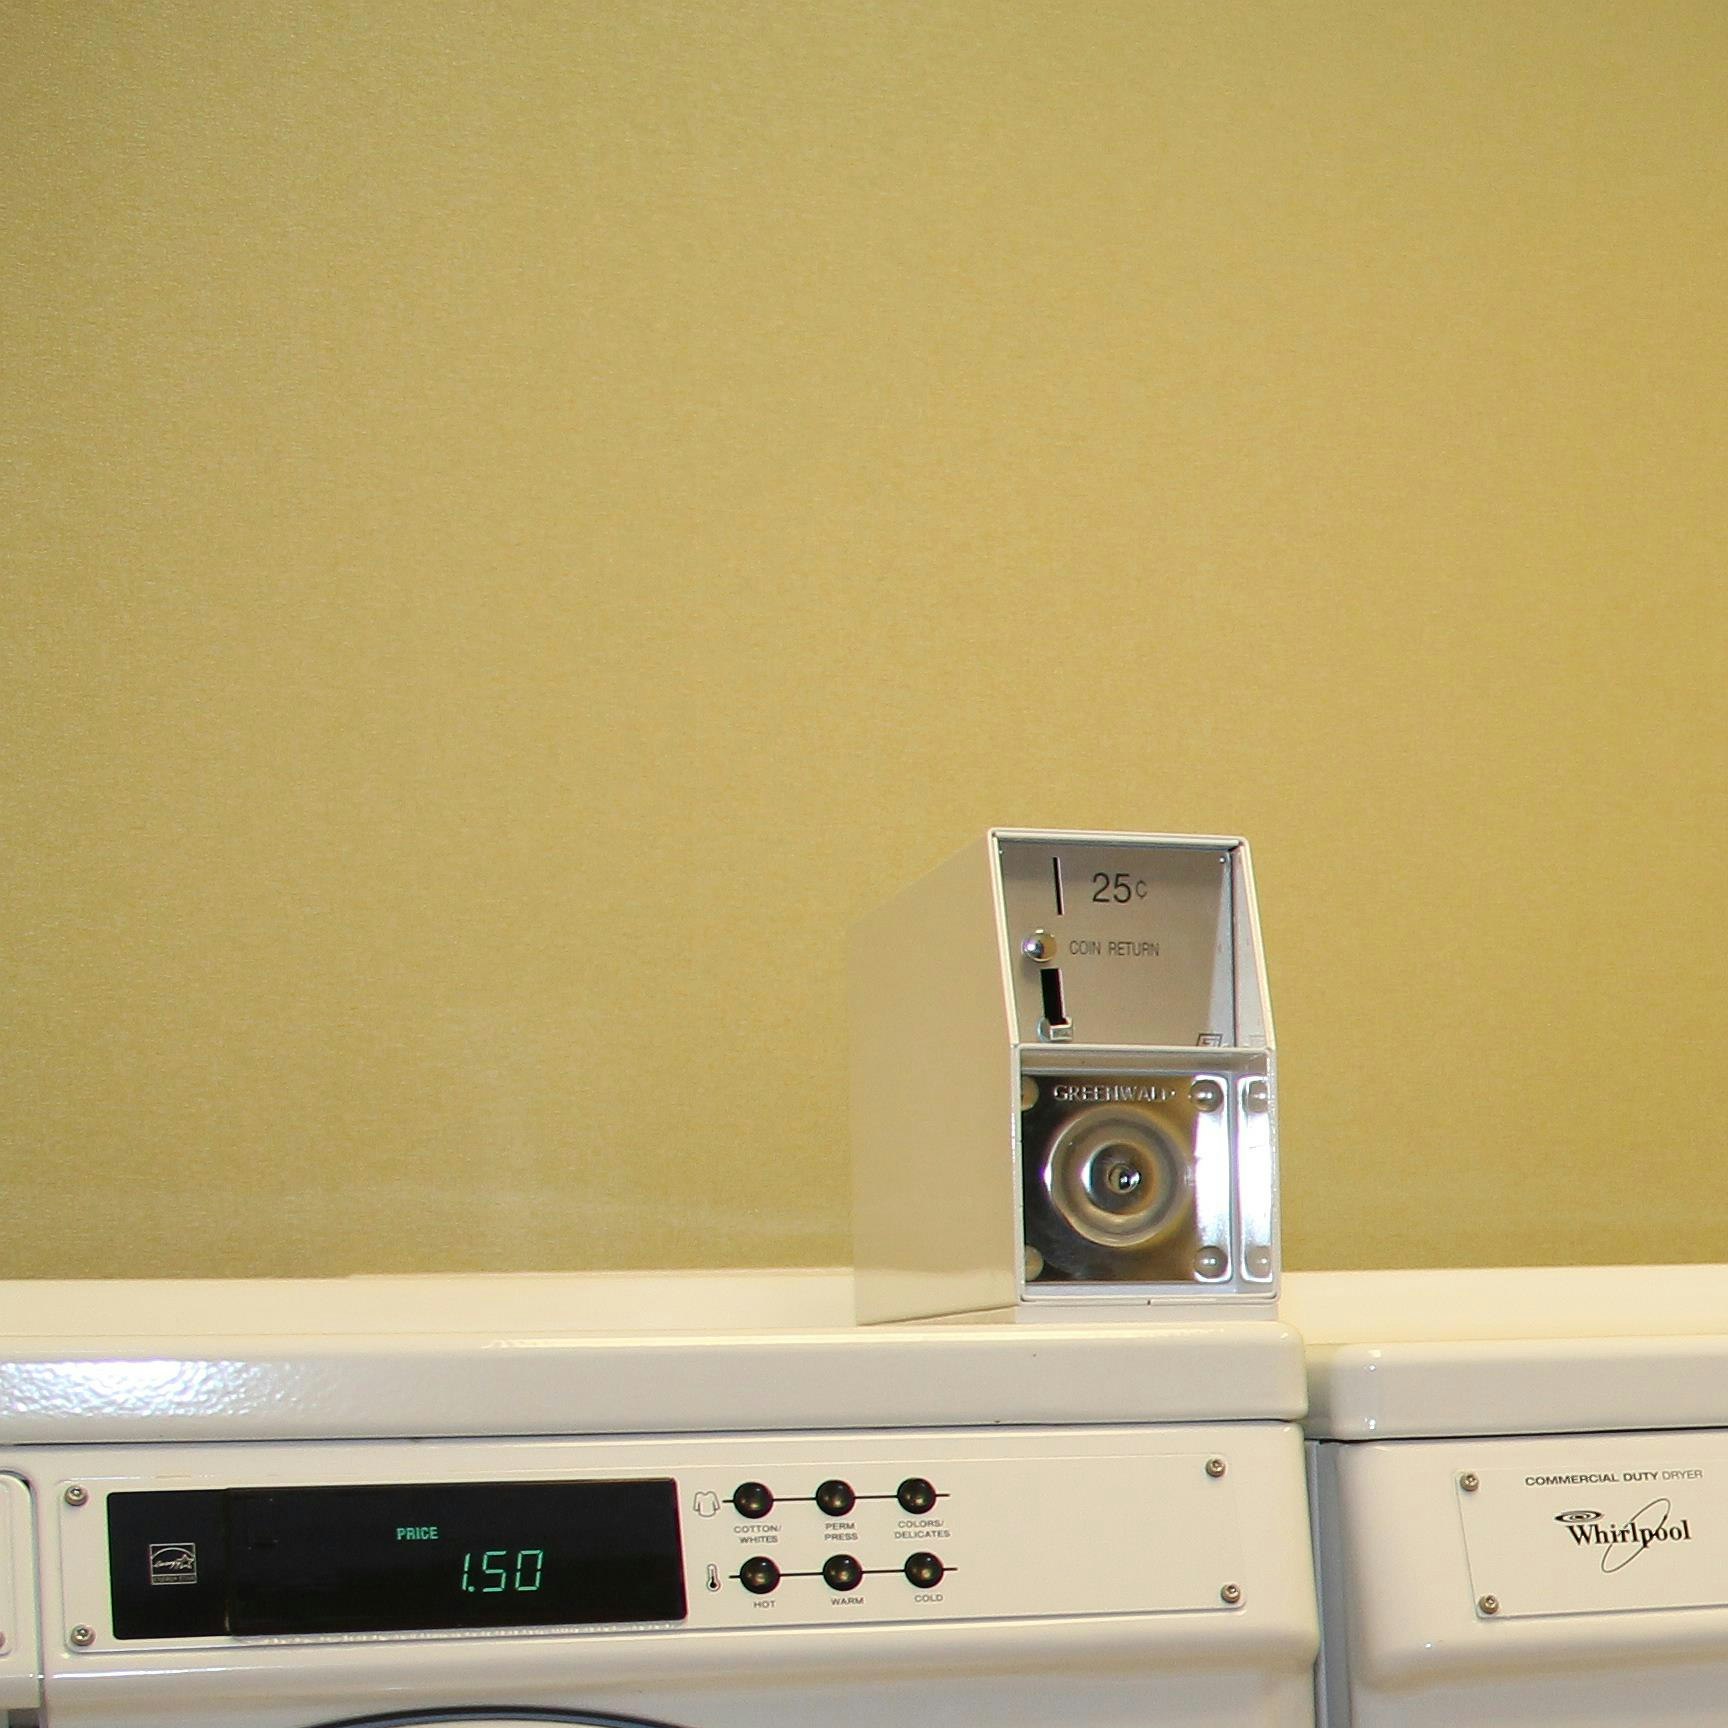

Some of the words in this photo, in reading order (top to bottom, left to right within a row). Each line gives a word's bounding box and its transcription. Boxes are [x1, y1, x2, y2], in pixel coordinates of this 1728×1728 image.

[1069, 940, 1101, 955] COIN
[1108, 941, 1160, 957] RETURN
[1525, 1473, 1619, 1487] COMMERCIAL
[1623, 1471, 1659, 1482] DUTY
[1662, 1469, 1704, 1481] DRYER
[733, 1524, 782, 1534] COTTON/
[825, 1521, 856, 1531] PERM
[897, 1519, 944, 1529] COLORS/
[396, 1526, 439, 1541] PRICE
[824, 1532, 859, 1541] PRESS
[894, 1529, 951, 1540] DELICATES
[1566, 1518, 1693, 1550] Whirlpool
[739, 1534, 779, 1544] WHITES
[461, 1549, 543, 1593] 1.50
[830, 1596, 865, 1606] WARM
[914, 1593, 944, 1603] COLD
[753, 1600, 777, 1609] HOT
